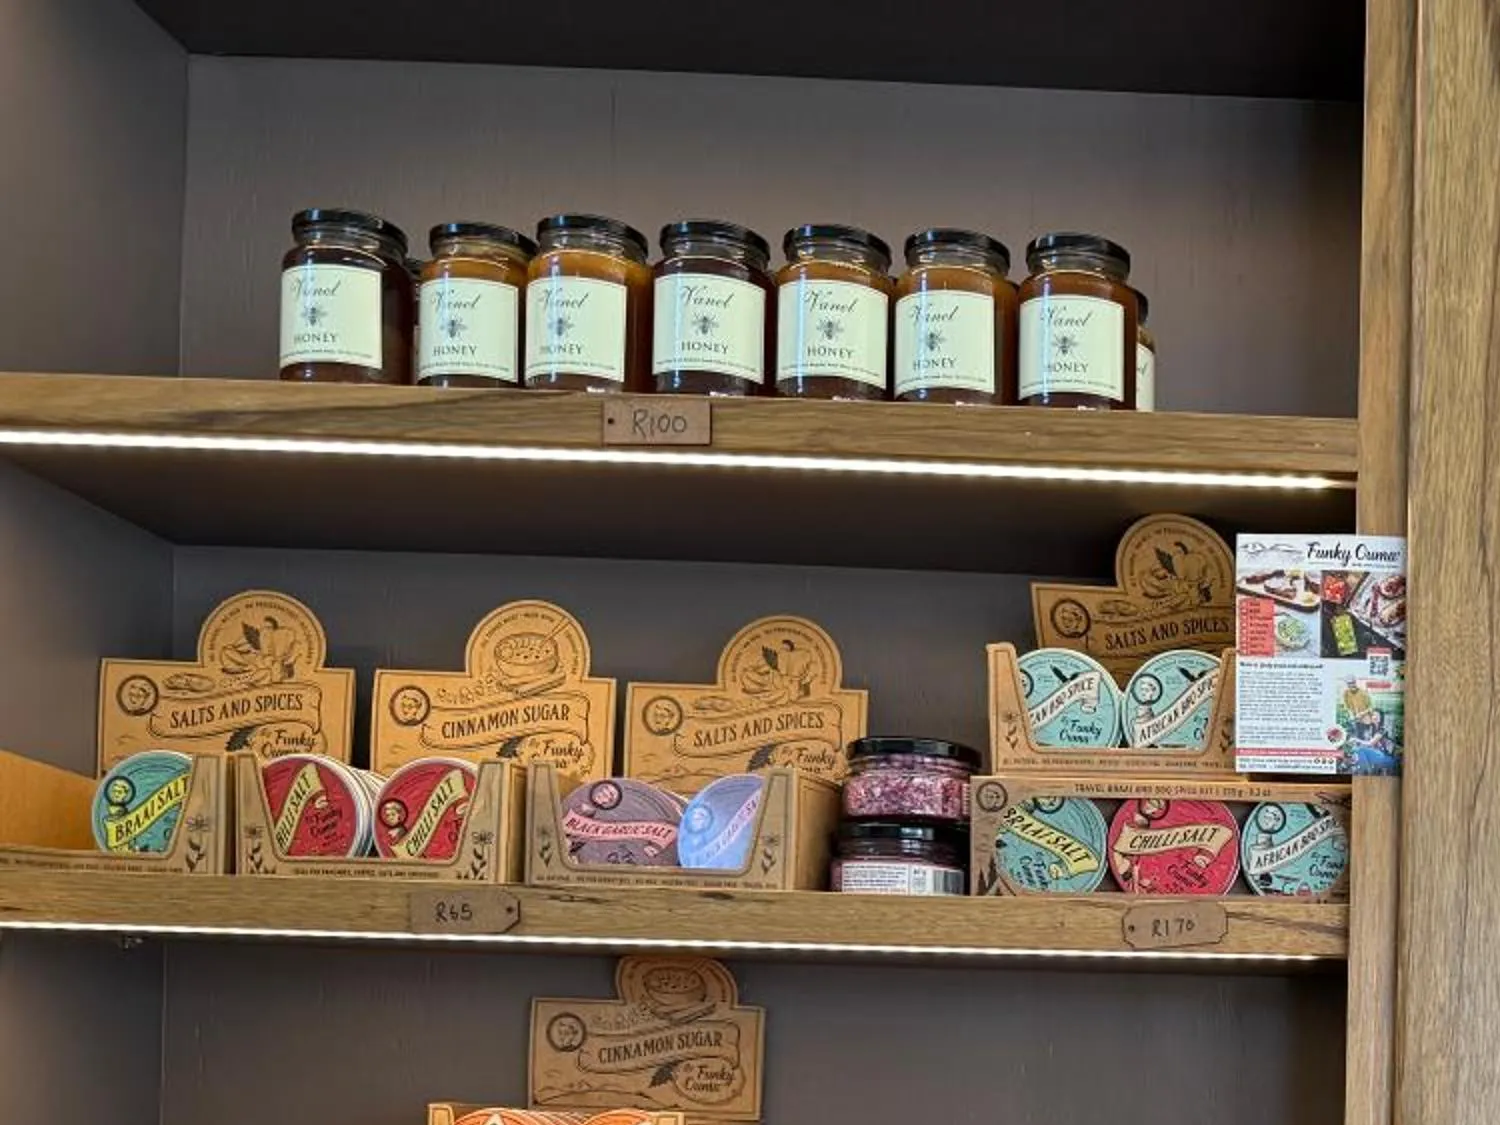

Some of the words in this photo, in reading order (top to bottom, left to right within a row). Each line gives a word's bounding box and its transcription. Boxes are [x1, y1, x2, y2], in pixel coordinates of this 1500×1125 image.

[294, 332, 339, 344] HONEY
[539, 344, 583, 355] HONEY
[681, 343, 728, 354] HONEY
[433, 346, 478, 357] HONEY
[807, 347, 852, 358] HONEY
[913, 358, 956, 370] HONEY
[1046, 362, 1088, 373] HONEY
[632, 408, 687, 439] R100
[1307, 542, 1351, 567] Funky
[1105, 628, 1147, 650] SALTS
[1150, 622, 1179, 642] AND
[1183, 617, 1229, 636] SPICES
[1070, 676, 1094, 701] SPICE
[170, 707, 215, 728] SALTS
[219, 701, 249, 720] AND
[255, 693, 303, 712] SPICES
[442, 709, 518, 737] CINNAMON
[521, 703, 569, 725] SUGAR
[693, 723, 738, 746] SALTS
[741, 719, 772, 739] AND
[775, 712, 824, 732] SPICES
[1070, 722, 1102, 740] Funky
[1140, 708, 1178, 740] AFRICAN
[274, 729, 316, 747] Funky
[543, 742, 584, 762] Funky
[796, 751, 836, 770] Funky
[296, 773, 312, 803] SALT
[114, 800, 155, 840] BRAAI
[156, 775, 188, 811] SALT
[406, 817, 433, 857] CHILLI
[431, 780, 455, 819] SALT
[1052, 834, 1089, 864] SALT
[1129, 831, 1177, 850] CHILLI
[1178, 828, 1220, 845] SALT
[1255, 840, 1300, 870] AFRICAN
[598, 1038, 674, 1065] CINNAMON
[677, 1031, 722, 1050] SUGAR
[697, 1064, 736, 1085] Funky
